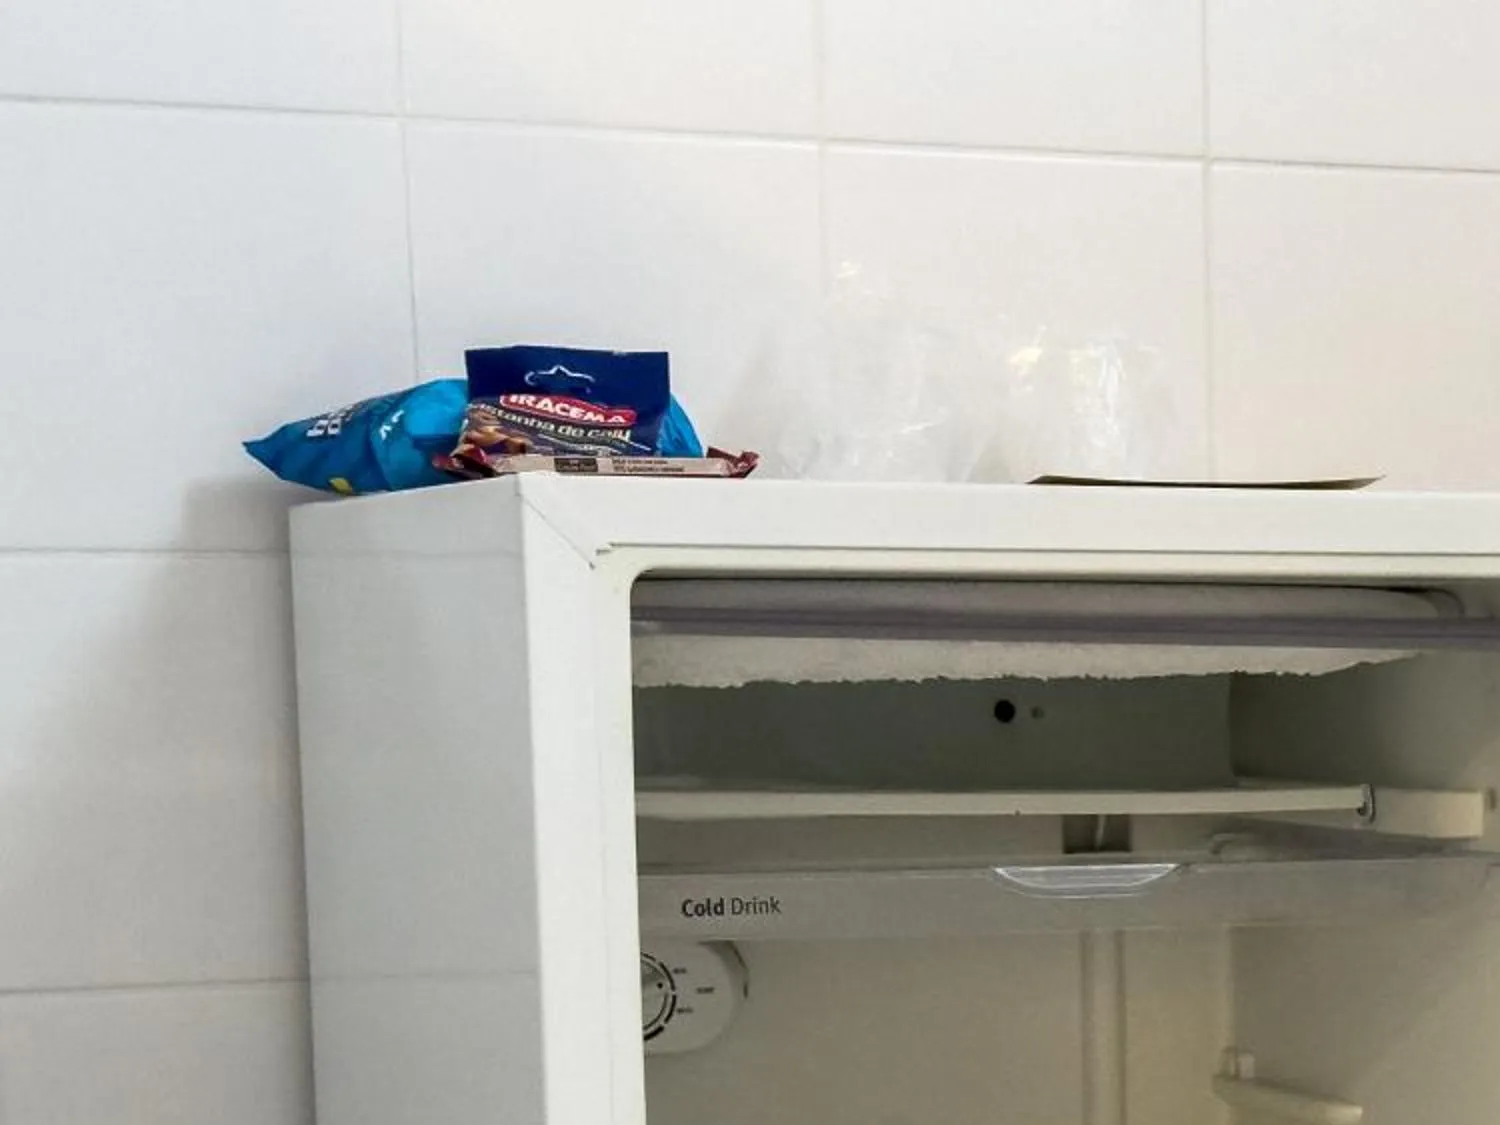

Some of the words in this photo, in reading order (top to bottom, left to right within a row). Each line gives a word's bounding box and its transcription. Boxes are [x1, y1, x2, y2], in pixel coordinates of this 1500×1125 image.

[507, 393, 626, 424] IRACEMA
[558, 424, 585, 438] de
[681, 897, 725, 918] Cold
[731, 896, 781, 916] Drink
